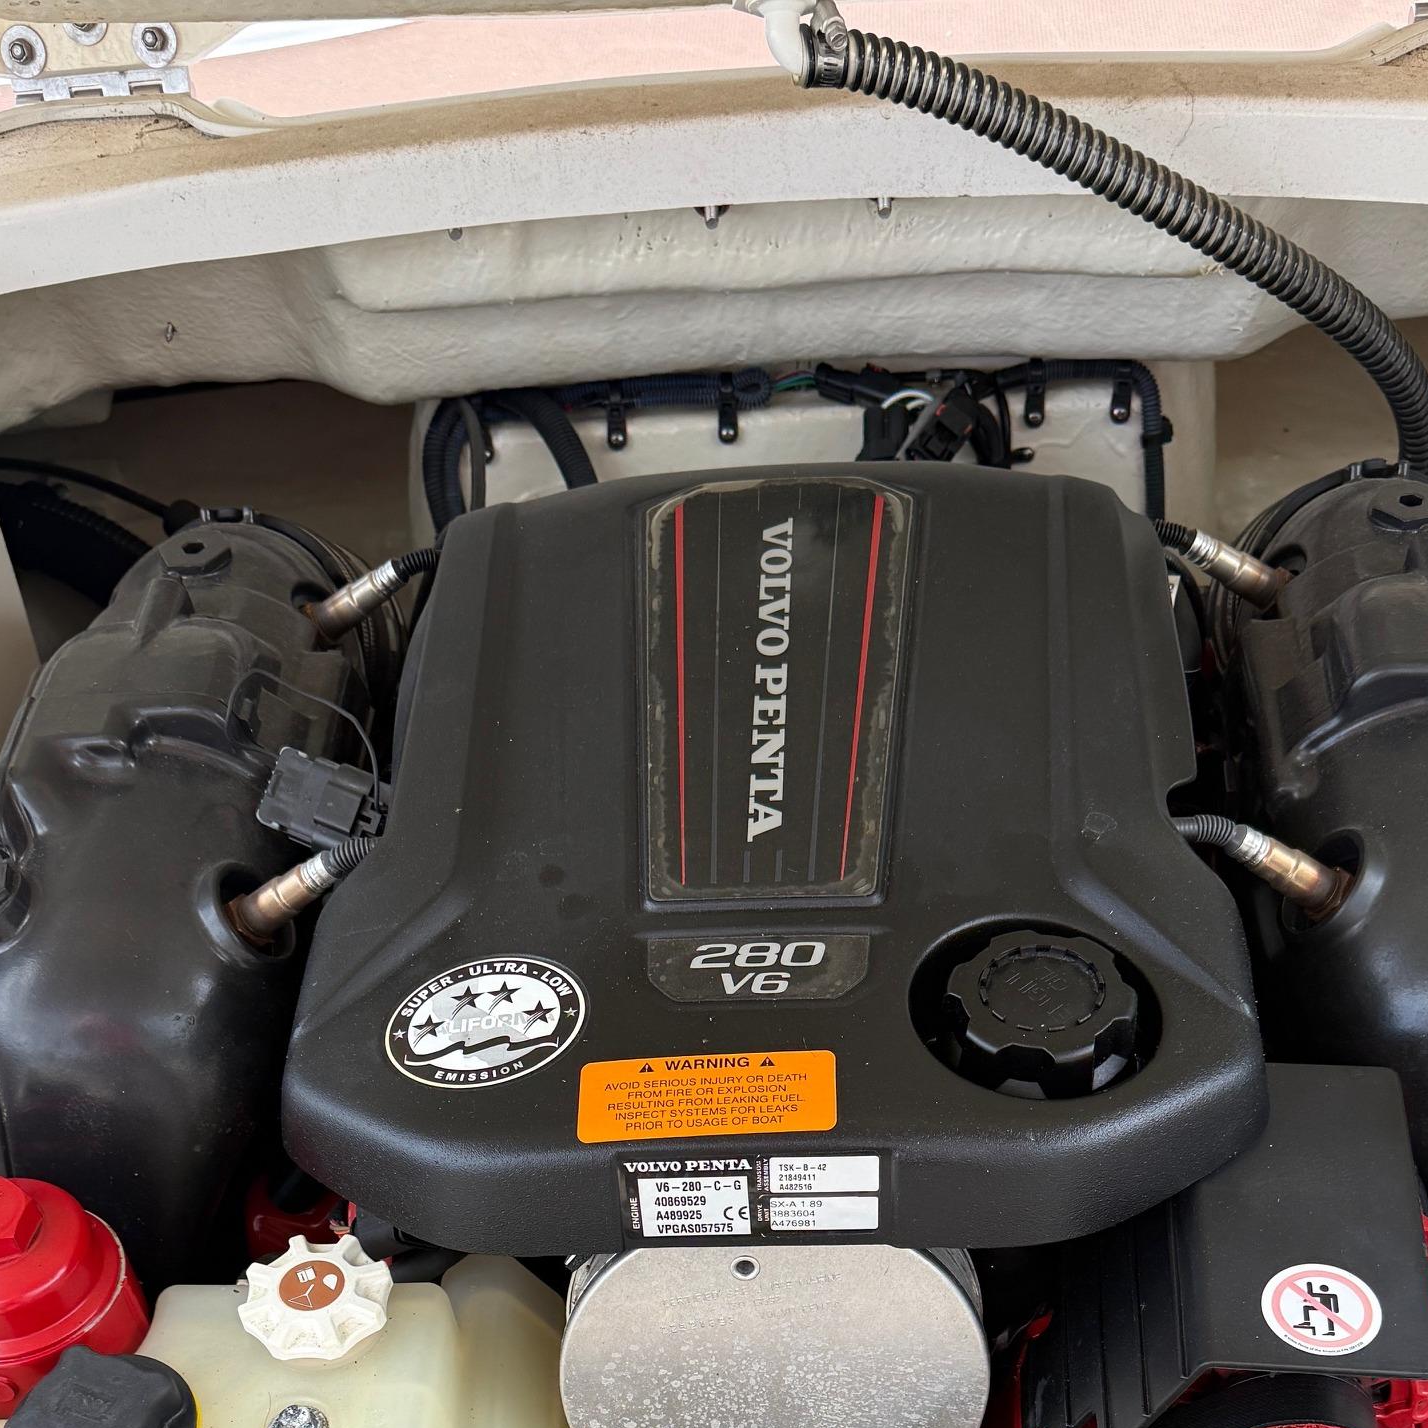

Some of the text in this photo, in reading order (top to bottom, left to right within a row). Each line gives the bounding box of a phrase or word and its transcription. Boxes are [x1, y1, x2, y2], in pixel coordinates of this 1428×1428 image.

[747, 516, 794, 842] VOLVO PENTA
[689, 940, 827, 969] 280
[400, 975, 455, 1018] SUPER
[468, 962, 528, 977] ULTRA
[540, 970, 573, 997] LOW
[719, 971, 792, 995] V6
[434, 1060, 525, 1082] EMISSION
[664, 1056, 750, 1071] WARNING
[604, 1073, 807, 1092] AVOID SERIOUS INJURY OR DEATH
[627, 1084, 788, 1100] FROM FIRE OR EXPLOSION
[607, 1100, 674, 1111] RESULTING
[678, 1097, 713, 1107] FROM
[716, 1095, 769, 1105] LEAKING
[615, 1103, 799, 1121] INSPECT SYSTEMS FOR LEAKS
[625, 1114, 784, 1132] PRIOR TO USAGE OF BOAT
[623, 1159, 753, 1173] VOLVO PENTA
[778, 1173, 817, 1181] 21849411
[779, 1183, 813, 1191] A482516
[654, 1196, 707, 1207] 40869529
[629, 1197, 641, 1230] ENGINE
[656, 1209, 703, 1221] A489925
[771, 1209, 815, 1217] 3883604
[657, 1222, 734, 1234] VPGAS057575
[771, 1219, 817, 1227] A476981
